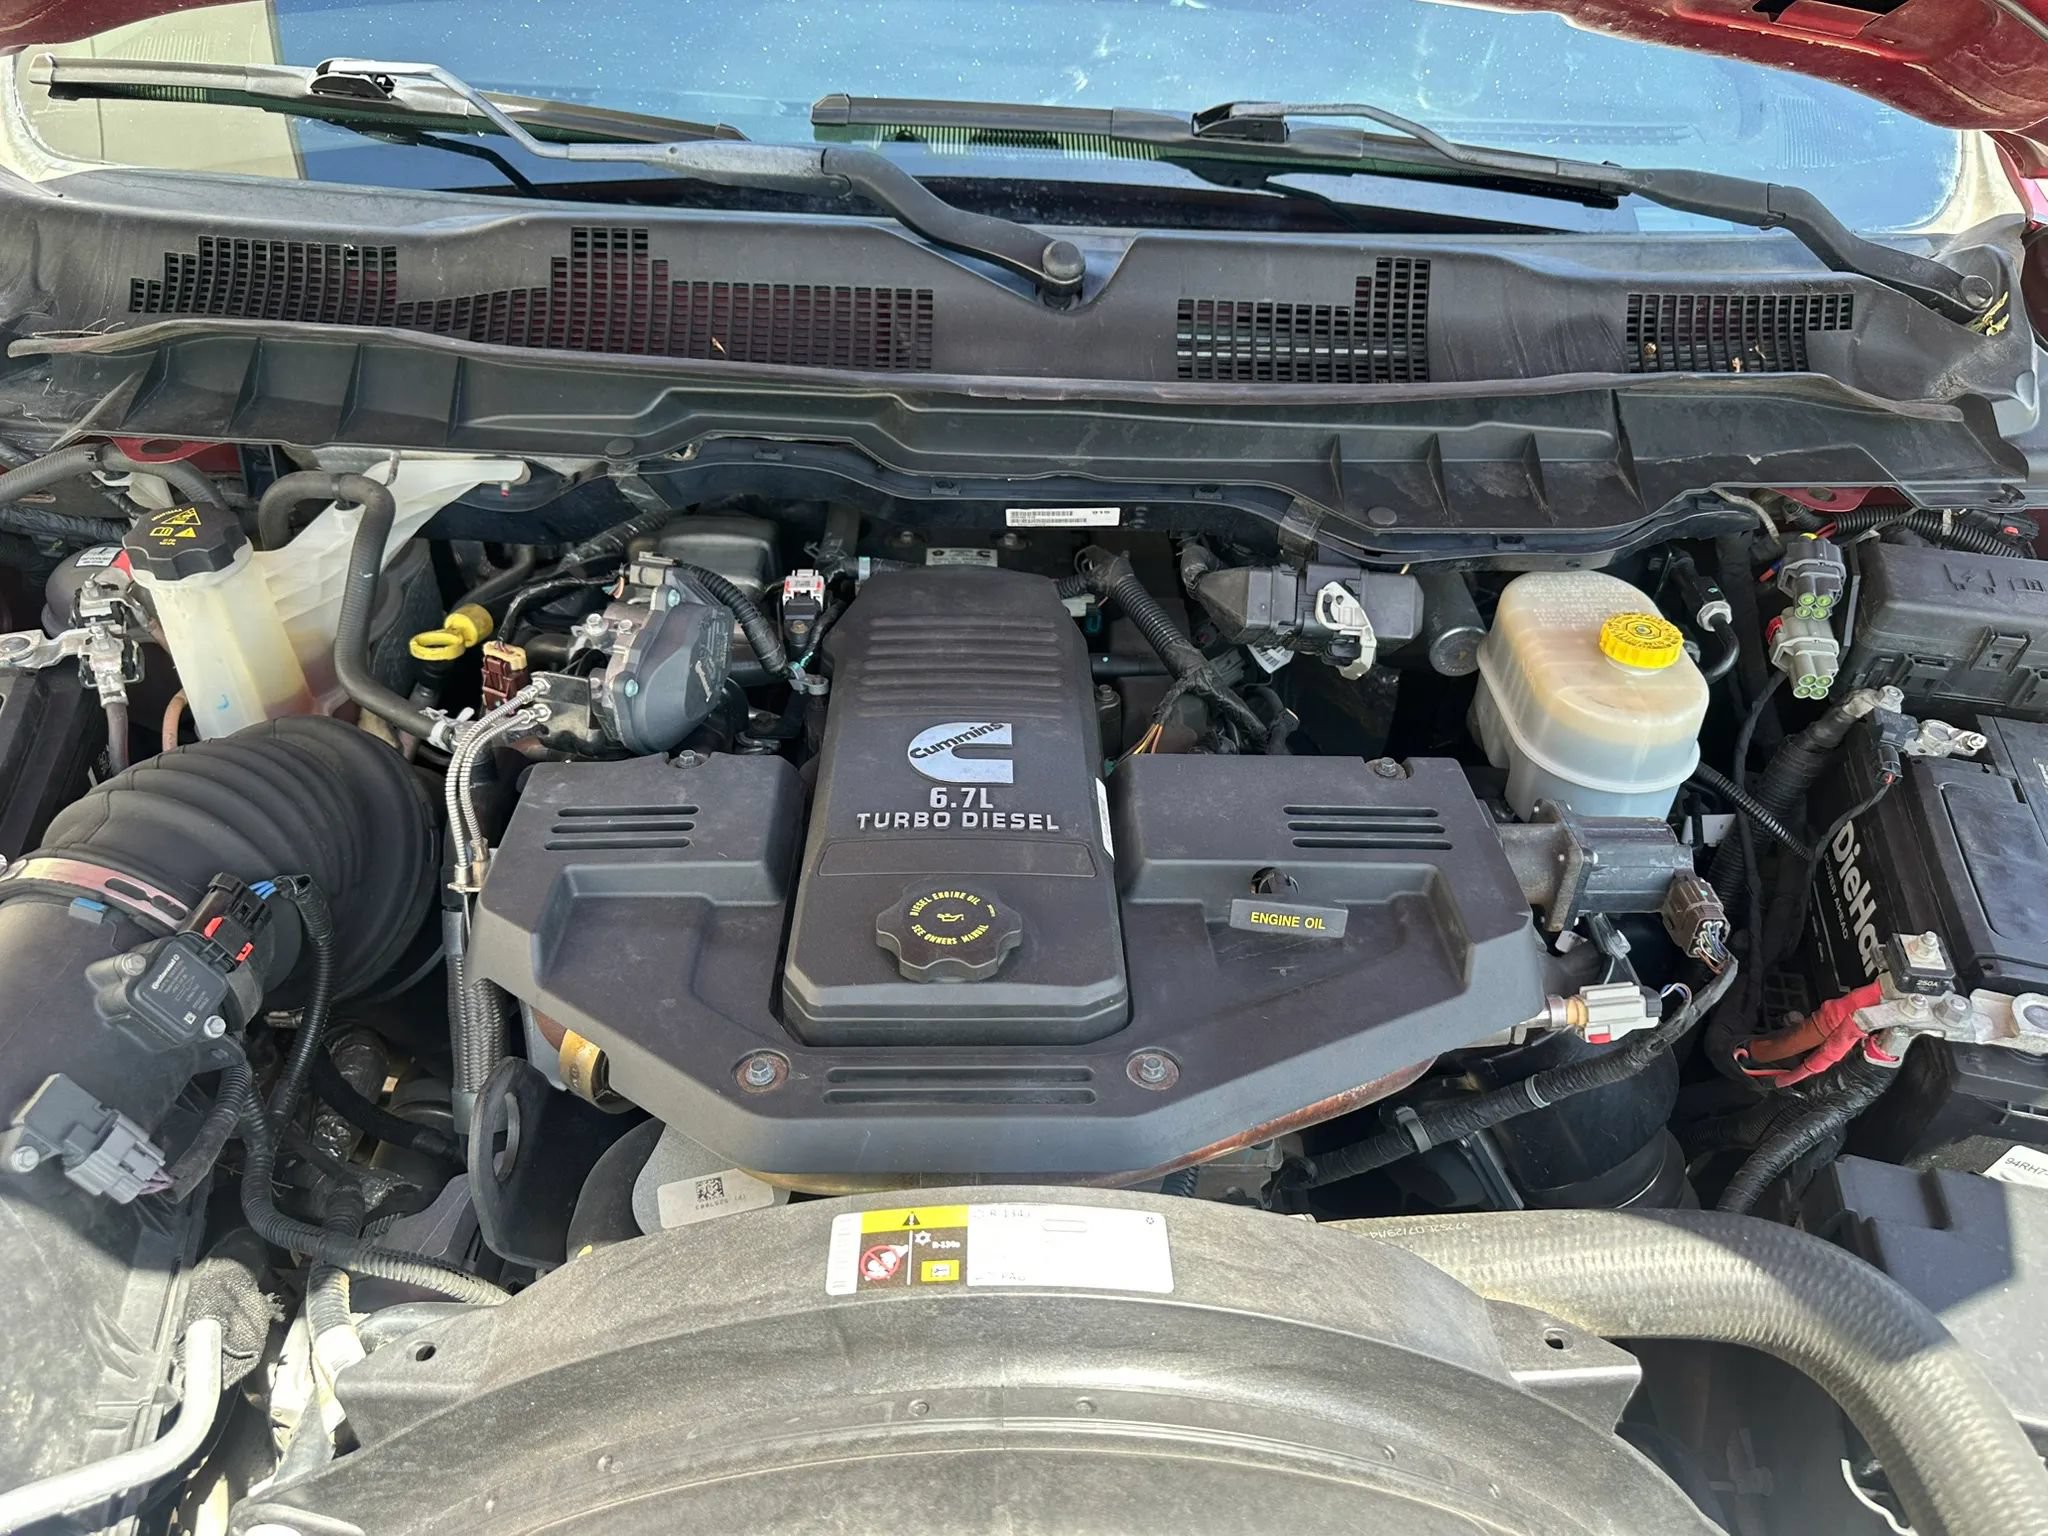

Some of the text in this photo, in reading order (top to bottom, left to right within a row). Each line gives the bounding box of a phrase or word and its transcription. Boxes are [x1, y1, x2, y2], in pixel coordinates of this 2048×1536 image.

[908, 721, 1004, 759] Cummins
[929, 787, 994, 809] 6.7L
[856, 811, 1061, 832] TURBO DIESEL
[909, 890, 982, 917] DIESEL ENGINE OIL
[1250, 911, 1327, 930] ENGINE OIL
[911, 923, 990, 946] SEE OWNERS MANUAL
